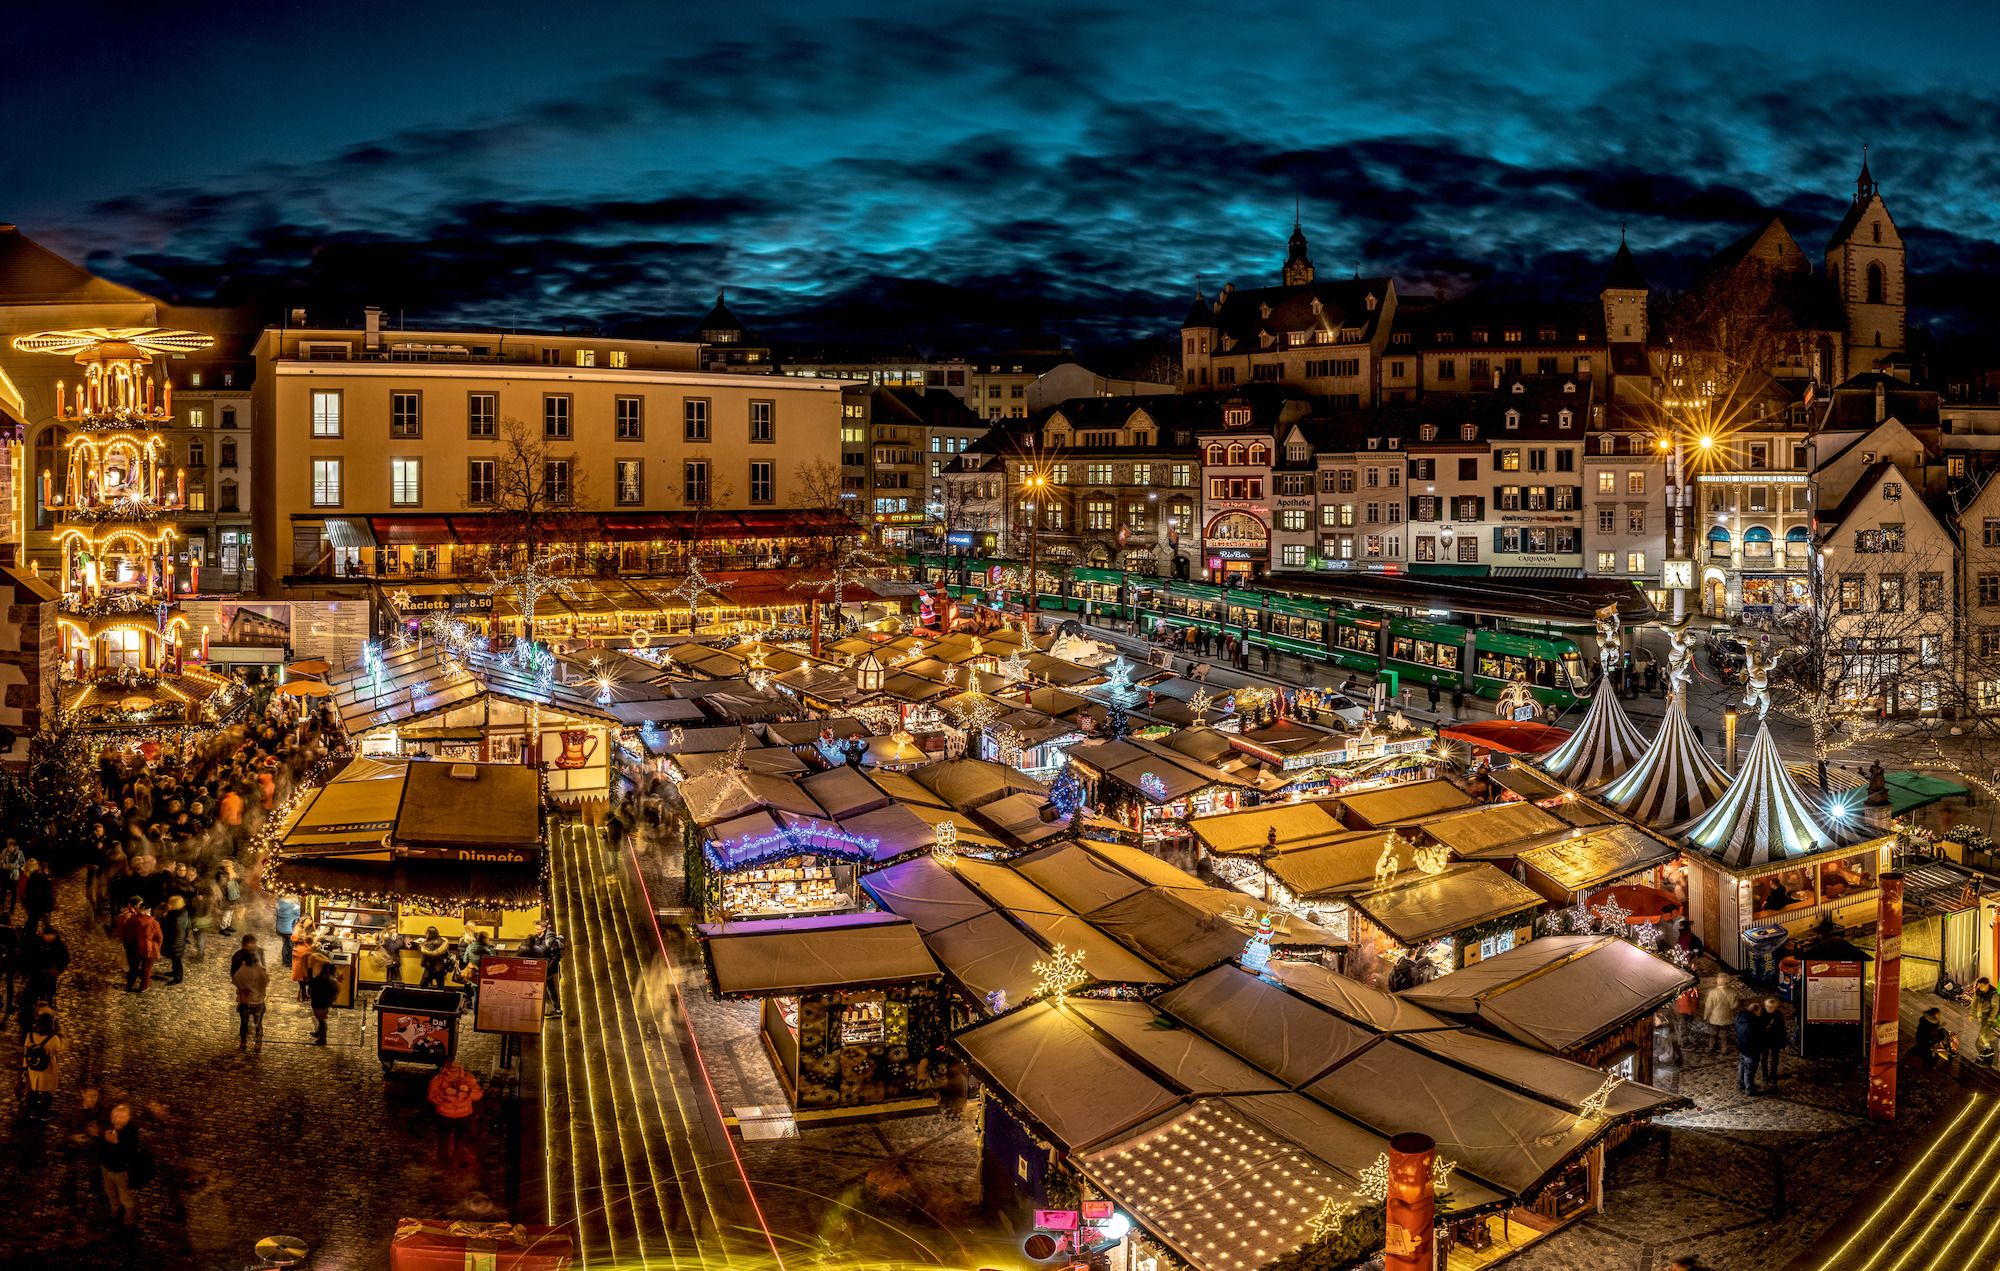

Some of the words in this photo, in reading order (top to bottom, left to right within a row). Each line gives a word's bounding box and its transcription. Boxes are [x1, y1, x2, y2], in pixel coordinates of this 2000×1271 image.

[1277, 499, 1311, 508] Apotheke
[402, 600, 450, 611] Raclette
[470, 598, 492, 608] 8.50
[317, 823, 391, 832] Dinnete
[432, 1019, 447, 1027] Da!
